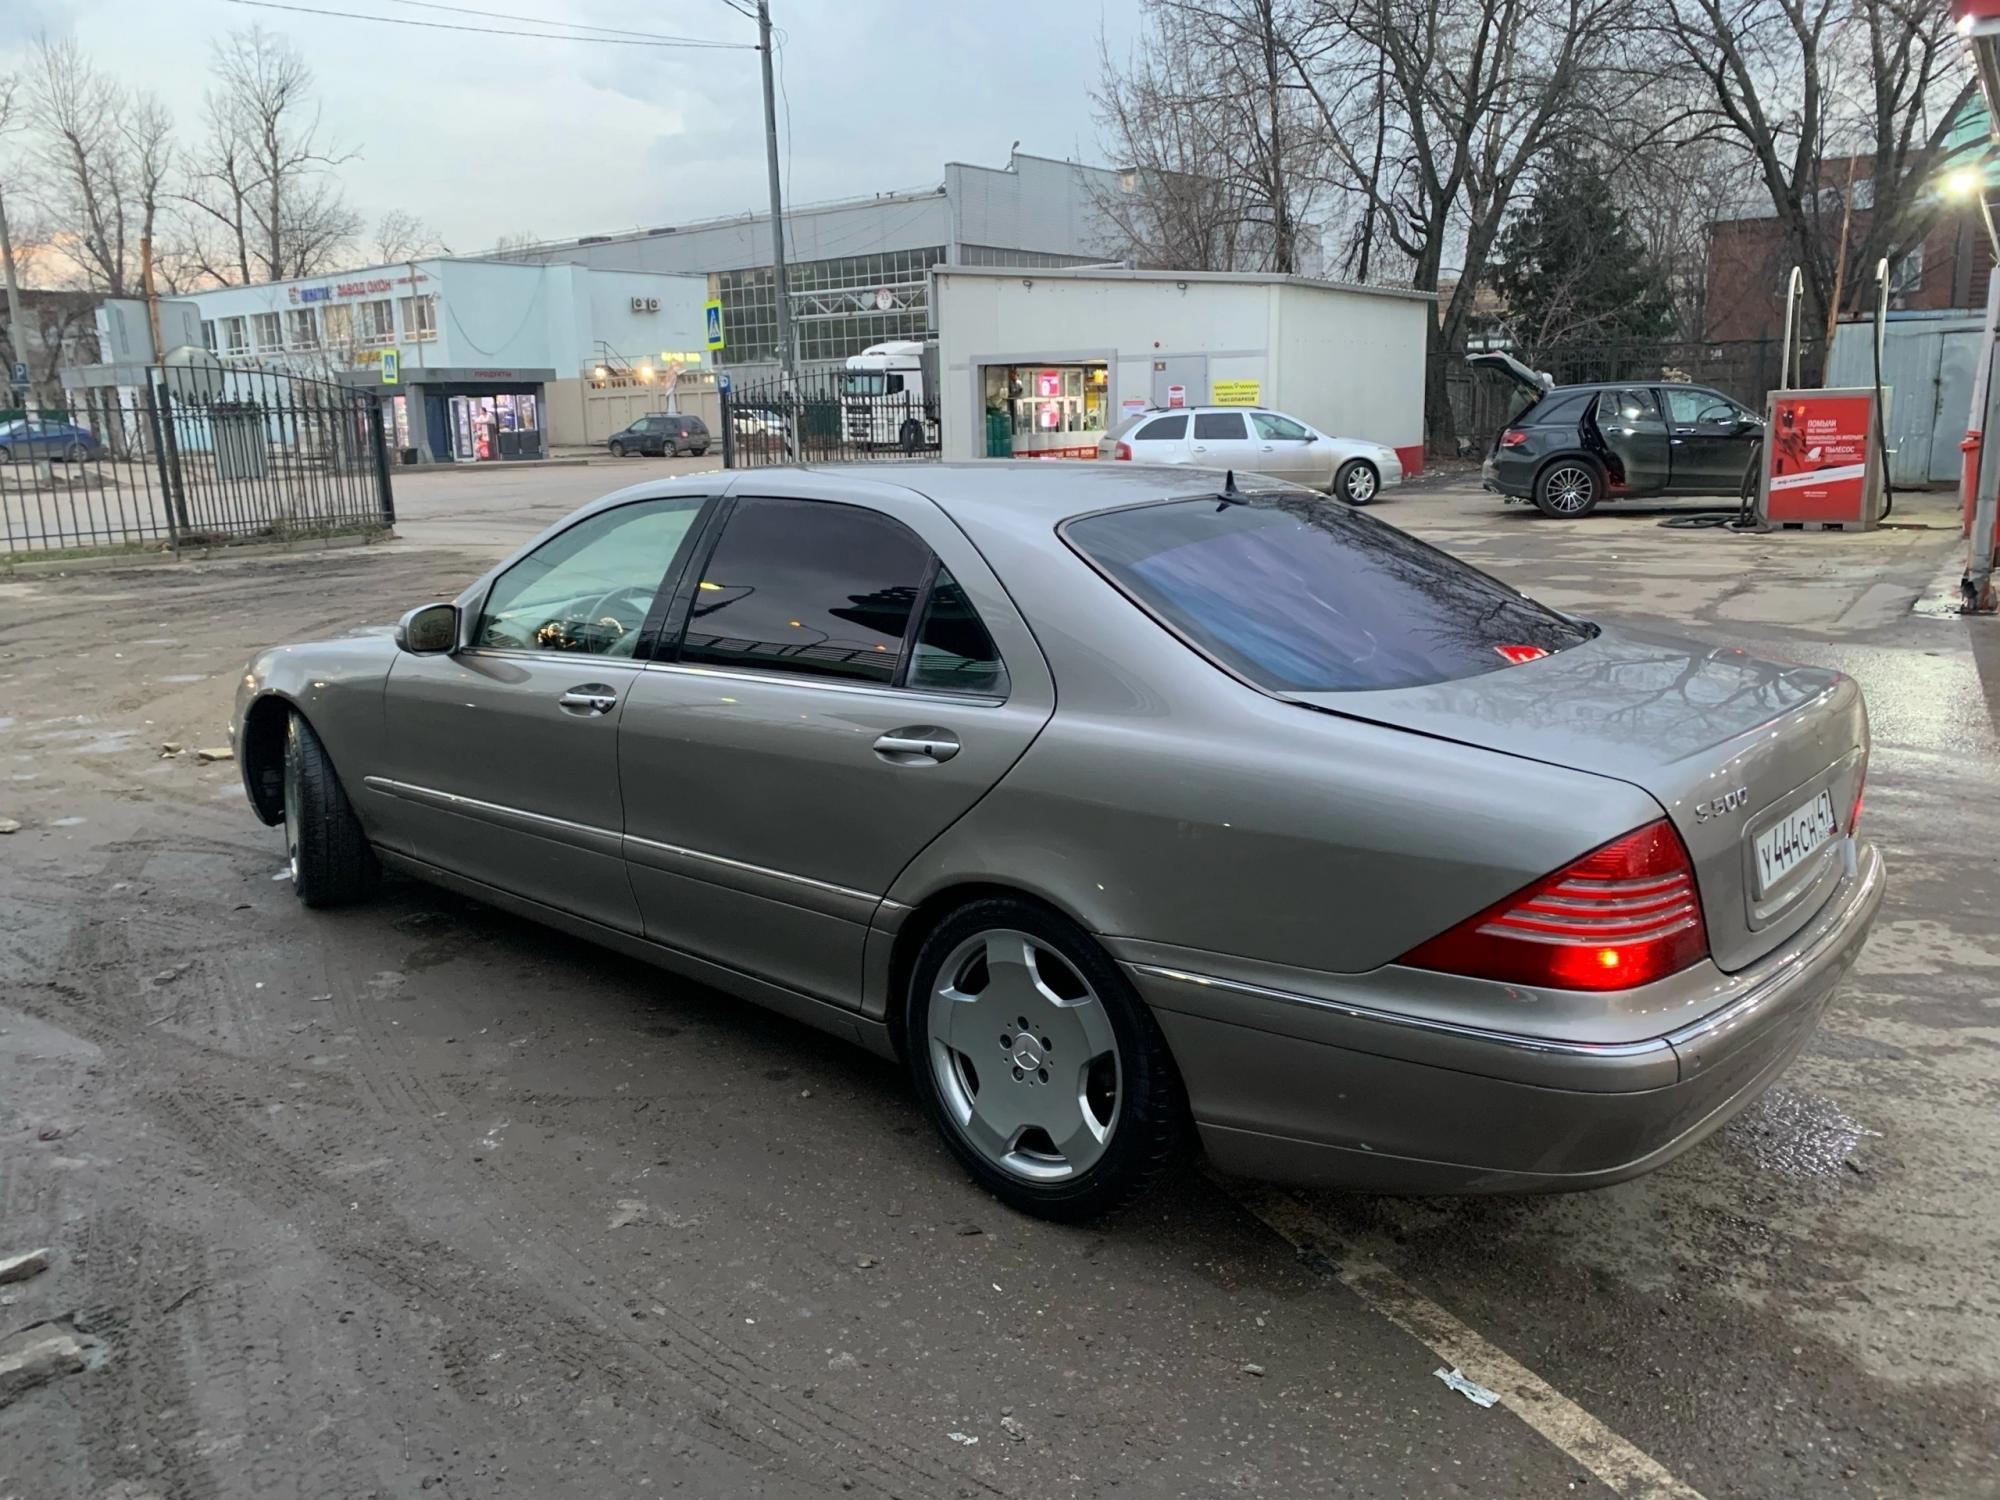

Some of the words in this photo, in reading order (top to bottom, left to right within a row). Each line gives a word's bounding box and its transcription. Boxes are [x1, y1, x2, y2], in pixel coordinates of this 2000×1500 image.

[474, 370, 512, 378] ПРОДУКТЫ
[1807, 419, 1837, 428] ПОМЫЛИ
[1825, 446, 1855, 454] ПЫЛЕСОС
